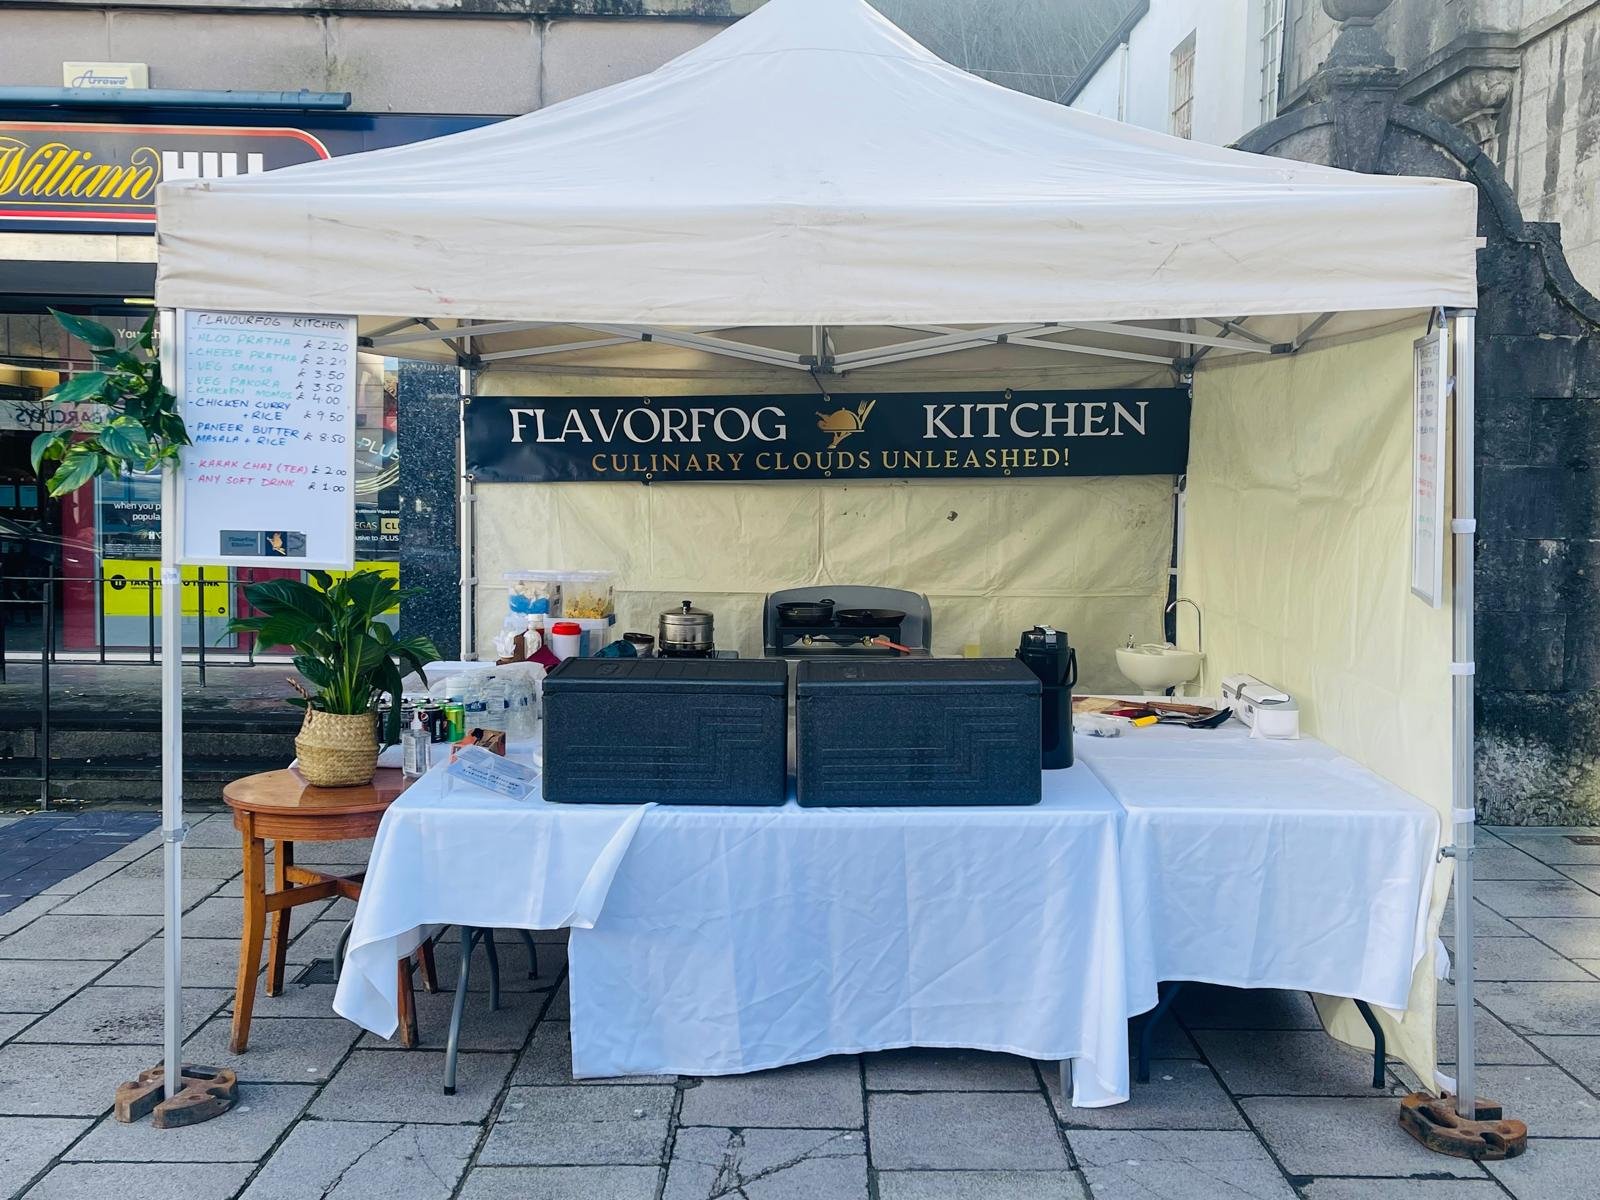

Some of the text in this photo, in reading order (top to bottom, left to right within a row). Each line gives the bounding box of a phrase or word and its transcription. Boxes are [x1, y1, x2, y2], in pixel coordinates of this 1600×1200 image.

[0, 136, 161, 200] William
[197, 314, 345, 330] FLAVOURFOG KITCHEN
[195, 348, 242, 358] CHEESE
[198, 360, 223, 371] VEG
[197, 376, 222, 386] VEG
[230, 377, 280, 388] PAKORA
[195, 398, 292, 410] CHICKEN CURRY
[252, 411, 284, 421] RICE
[509, 401, 1150, 443] FLAVORFOG KITCHEN
[196, 422, 244, 432] PANEER
[252, 425, 300, 439] BUTTER
[195, 434, 240, 444] MASALA
[257, 436, 288, 446] RICE
[592, 448, 1070, 472] CULINARY CLOUDS UNLEASHED!
[198, 458, 240, 468] KARAK
[243, 462, 273, 472] CHAI
[276, 464, 310, 475] (TEA)
[198, 474, 221, 483] ANY
[226, 476, 256, 486] SOFT
[260, 478, 296, 488] DRINK
[113, 502, 137, 510] when
[138, 503, 154, 512] you
[132, 512, 161, 522] popula
[354, 521, 378, 530] EGAS
[385, 522, 400, 530] CL
[355, 534, 370, 542] usive
